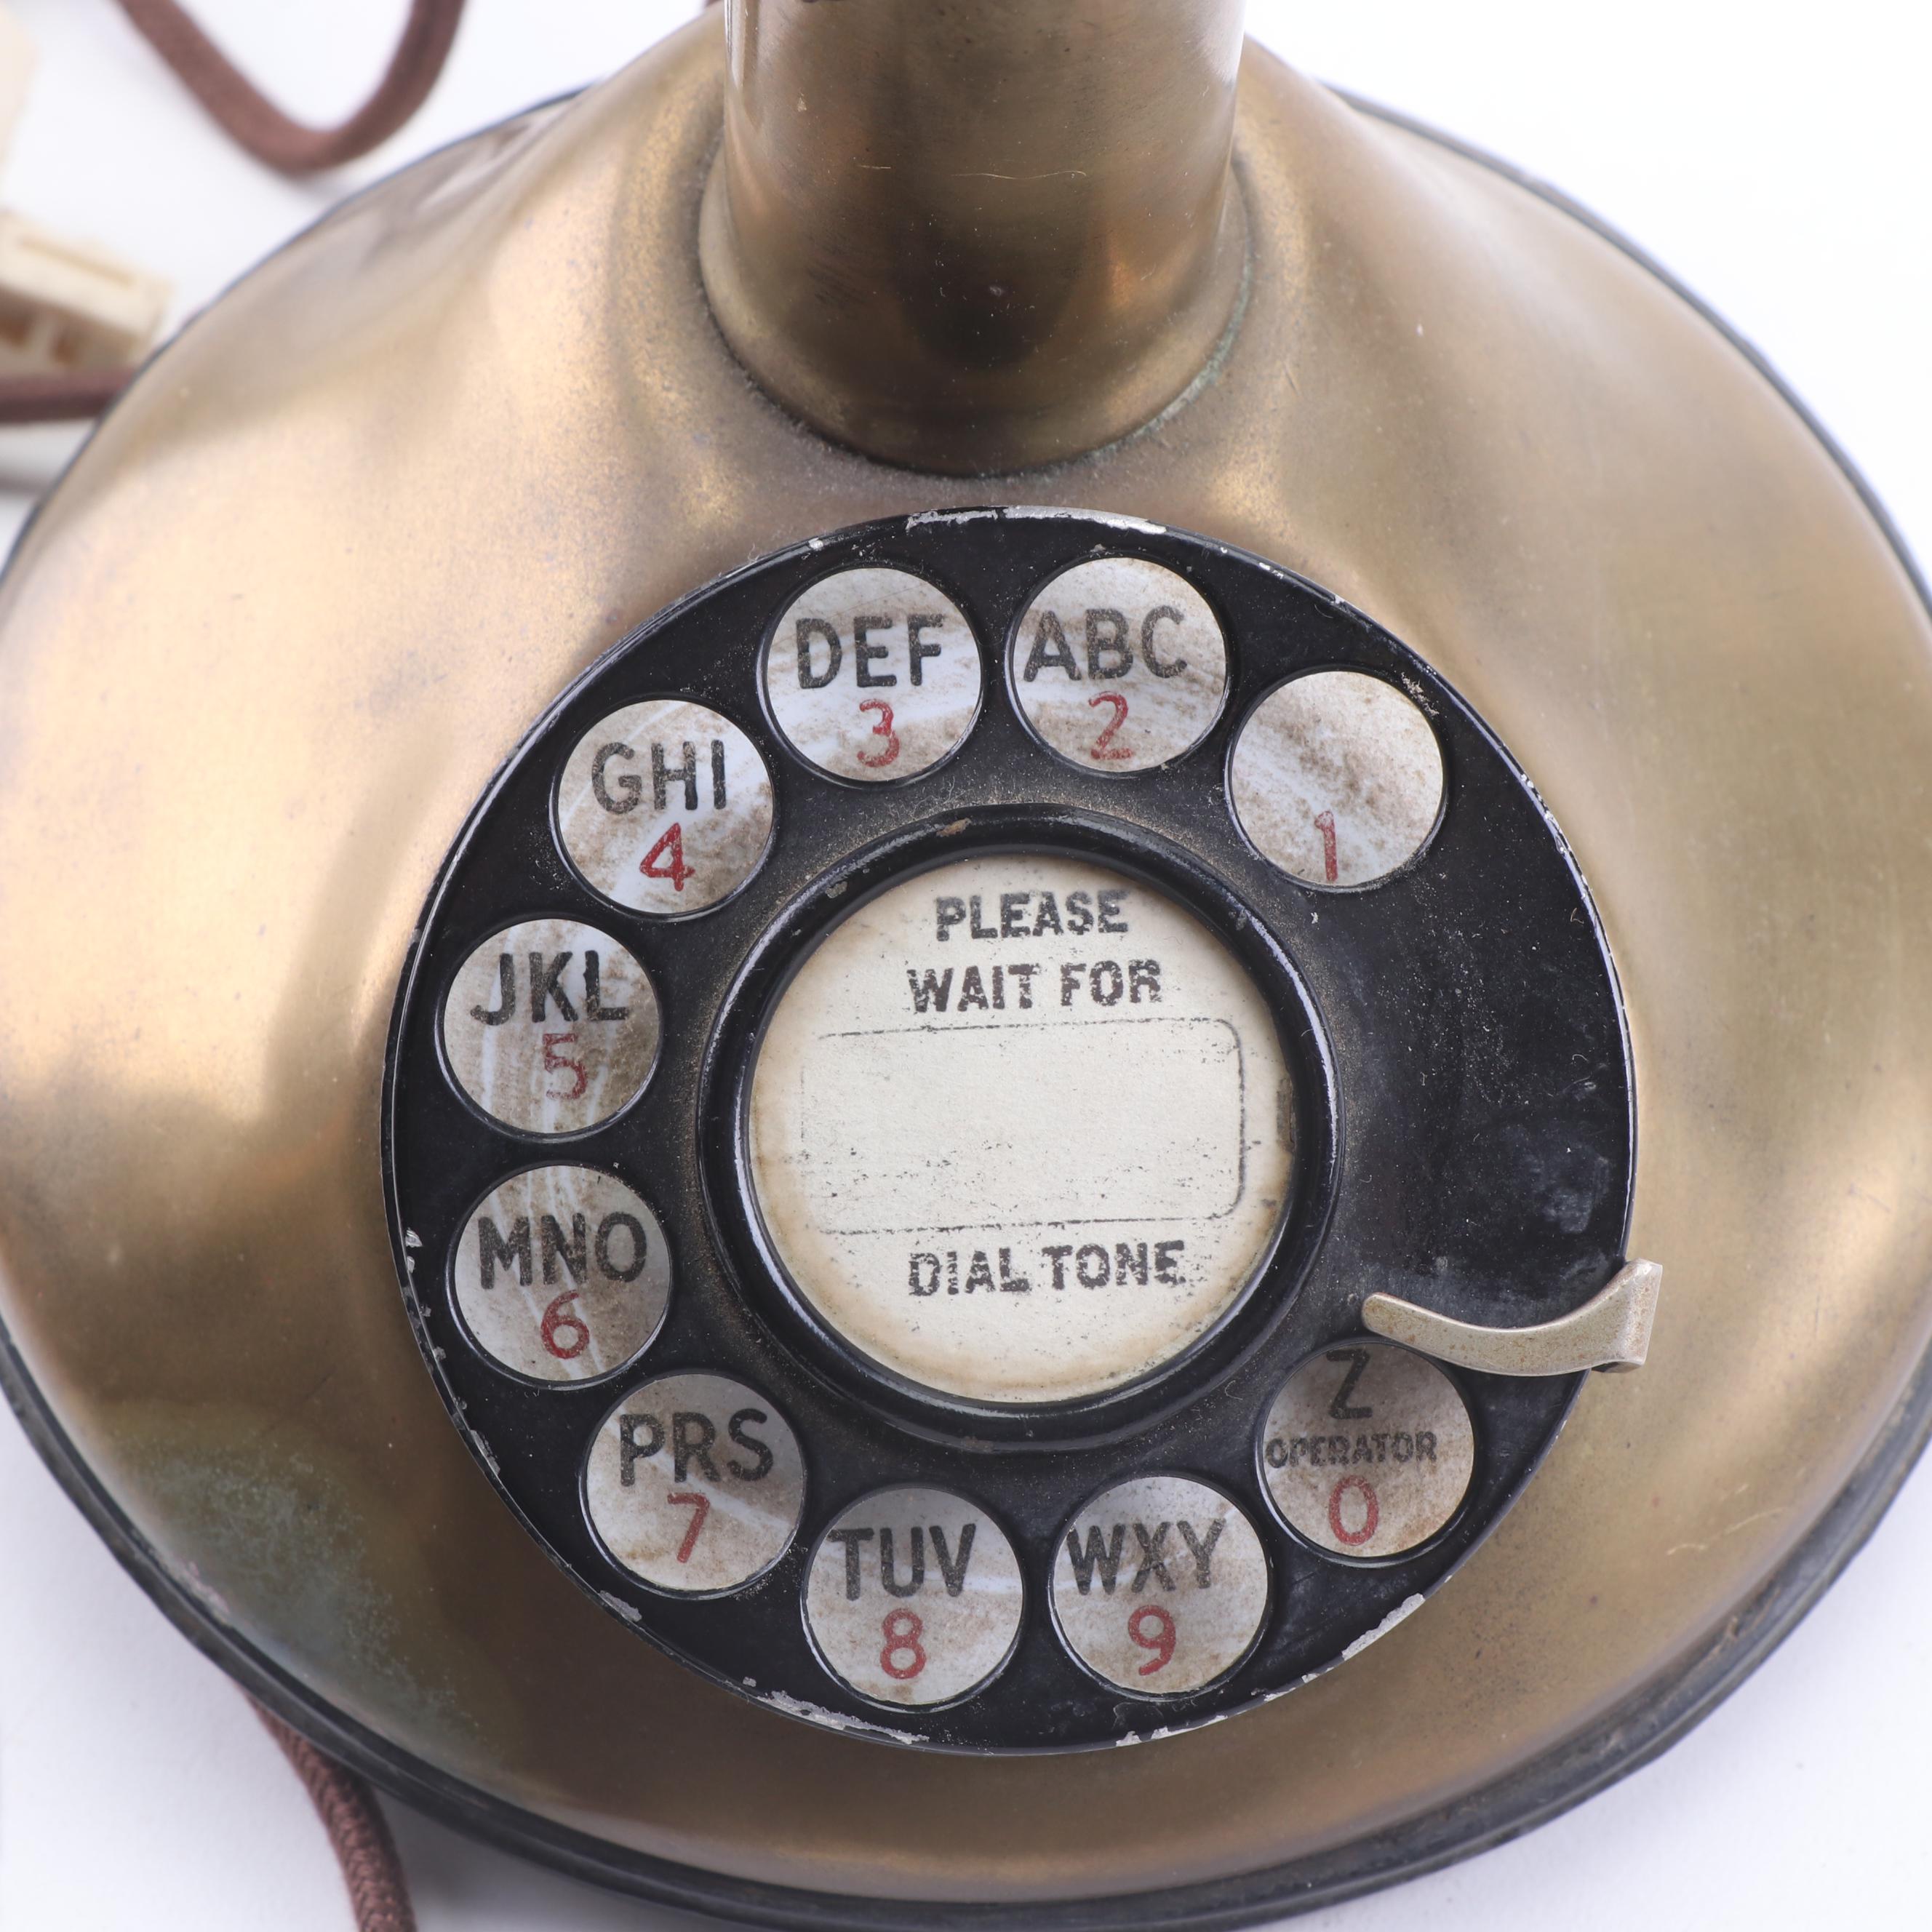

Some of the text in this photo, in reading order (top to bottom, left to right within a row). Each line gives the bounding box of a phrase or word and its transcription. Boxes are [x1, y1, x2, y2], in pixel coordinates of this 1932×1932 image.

[796, 614, 946, 689] DEF
[1023, 605, 1188, 682] ABC
[857, 700, 900, 768] 3
[1089, 691, 1133, 759] 2
[591, 739, 726, 814] GHI
[640, 823, 695, 891] 4
[1314, 810, 1338, 883] 1
[934, 888, 1130, 941] PLEASE
[470, 950, 629, 1026] JKL
[907, 959, 1163, 1013] WAIT FOR
[542, 1032, 588, 1100] 5
[477, 1212, 648, 1289] MNO
[908, 1240, 1185, 1296] DIAL TONE
[540, 1290, 590, 1360] 6
[1325, 1348, 1373, 1419] Z
[618, 1408, 773, 1487] PRS
[1266, 1431, 1438, 1469] OPERATOR
[667, 1493, 710, 1563] 7
[1328, 1476, 1379, 1546] 0
[826, 1523, 976, 1601] TUV
[1066, 1519, 1226, 1596] WXY
[879, 1608, 927, 1679] 8
[1127, 1605, 1176, 1676] 9
